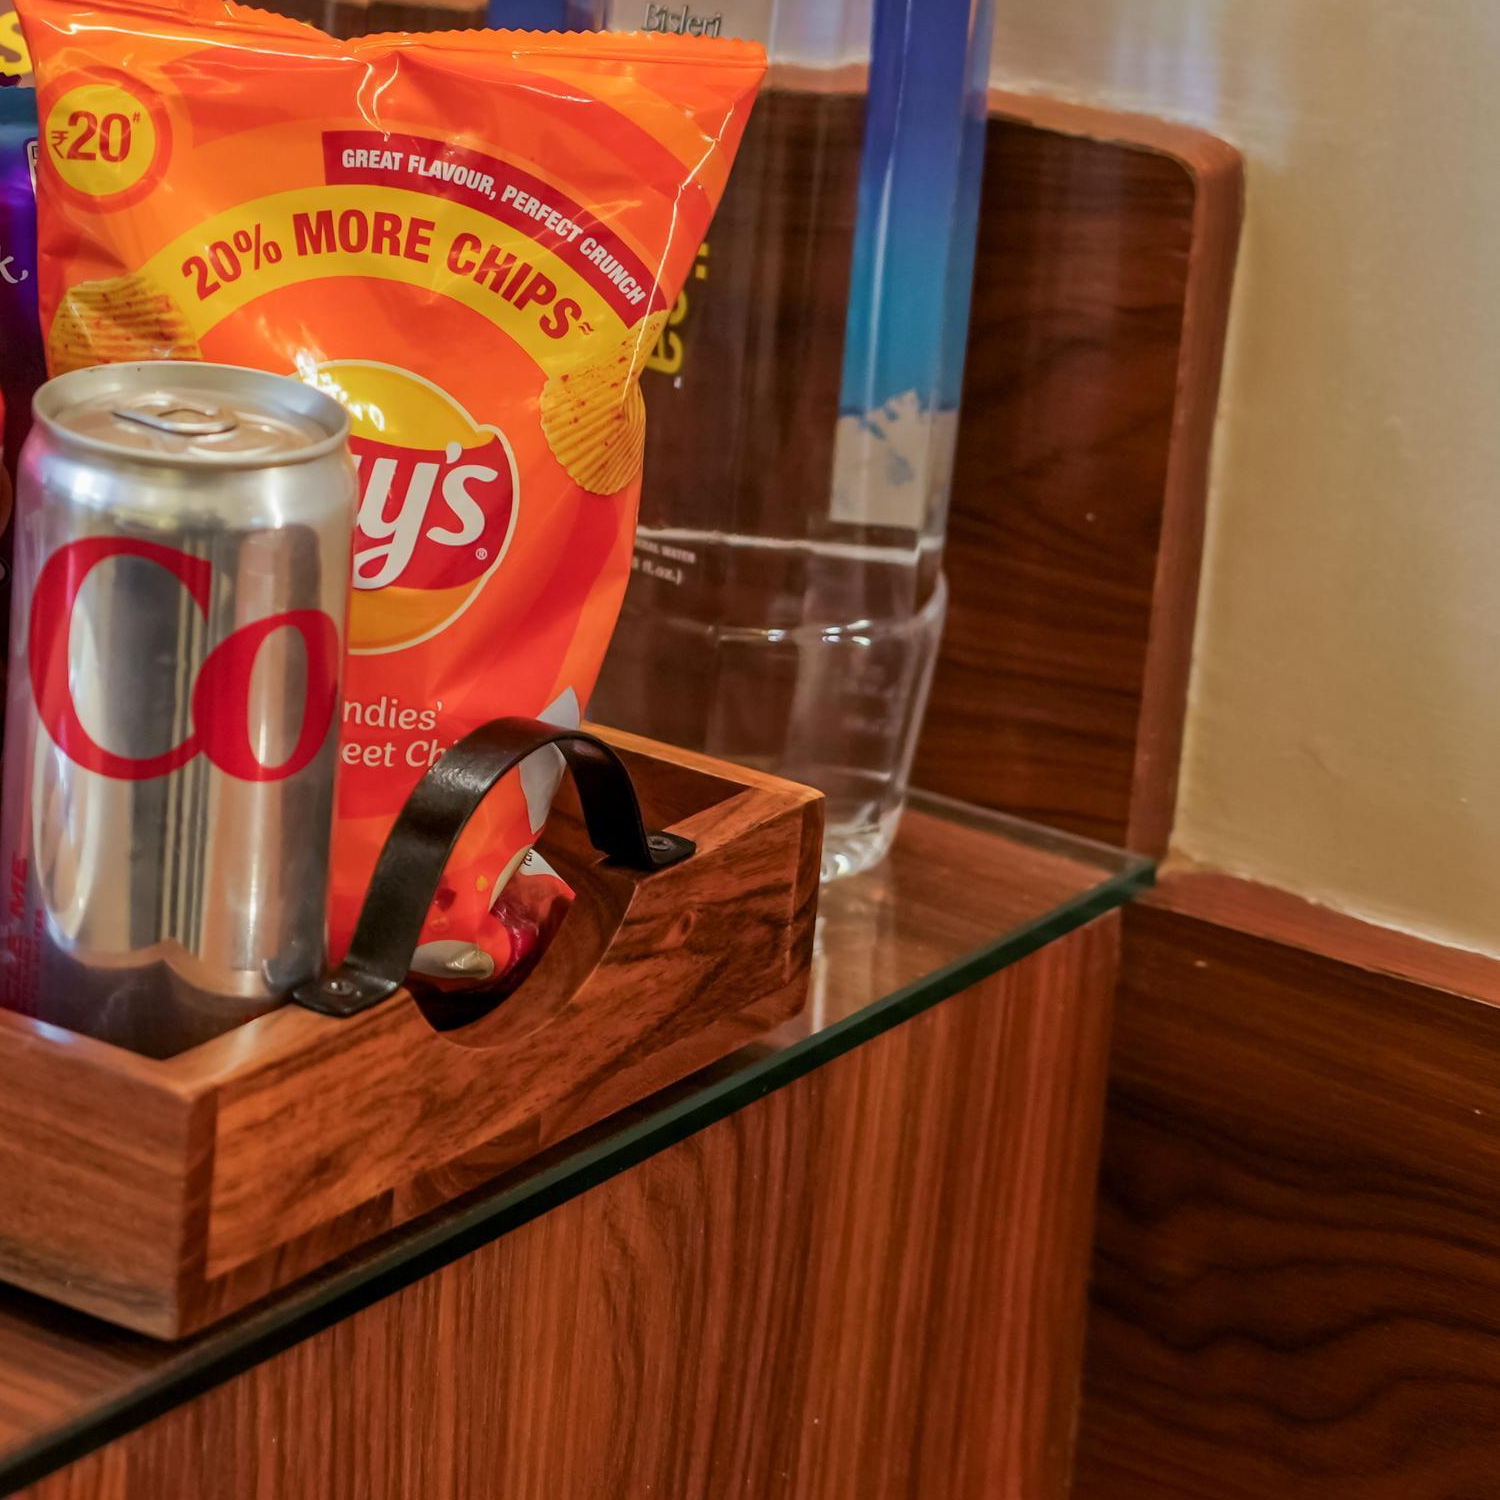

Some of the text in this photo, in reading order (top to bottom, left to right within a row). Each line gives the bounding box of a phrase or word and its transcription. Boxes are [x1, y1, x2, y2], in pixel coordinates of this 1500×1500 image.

[641, 2, 723, 39] Bisleri
[341, 148, 647, 306] GREAT FLAVOUR, PERFECT CRUNCH
[181, 223, 284, 301] 20%
[292, 208, 436, 264] MORE
[446, 232, 584, 340] CHIPS
[351, 441, 499, 590] y's
[341, 741, 397, 768] eet
[343, 695, 443, 731] ndies'
